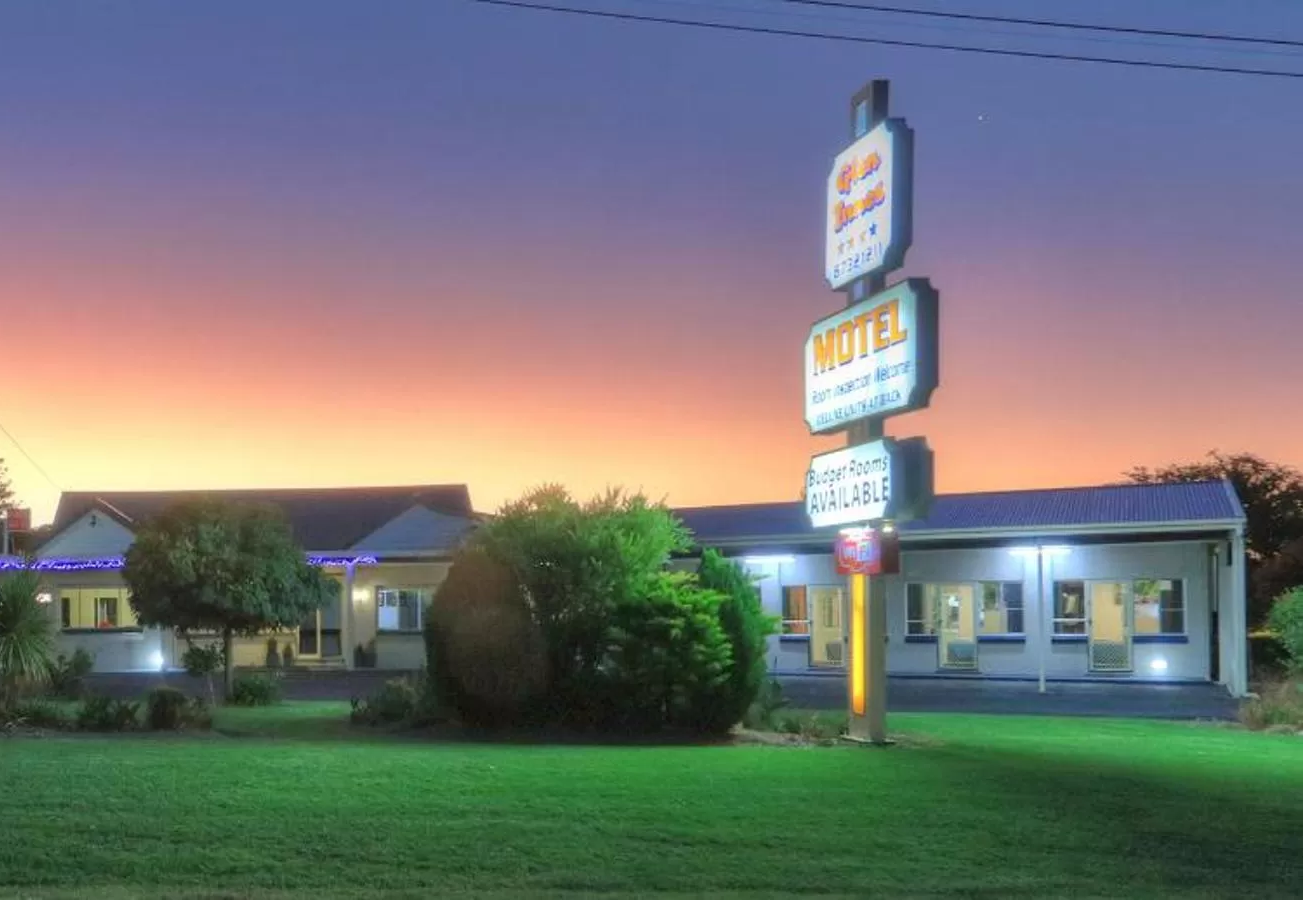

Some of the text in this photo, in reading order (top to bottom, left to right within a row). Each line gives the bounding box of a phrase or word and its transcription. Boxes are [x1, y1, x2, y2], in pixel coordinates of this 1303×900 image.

[812, 298, 908, 376] MOTEL
[808, 455, 889, 489] Budget Rooms
[810, 476, 890, 515] AVAILABLE
